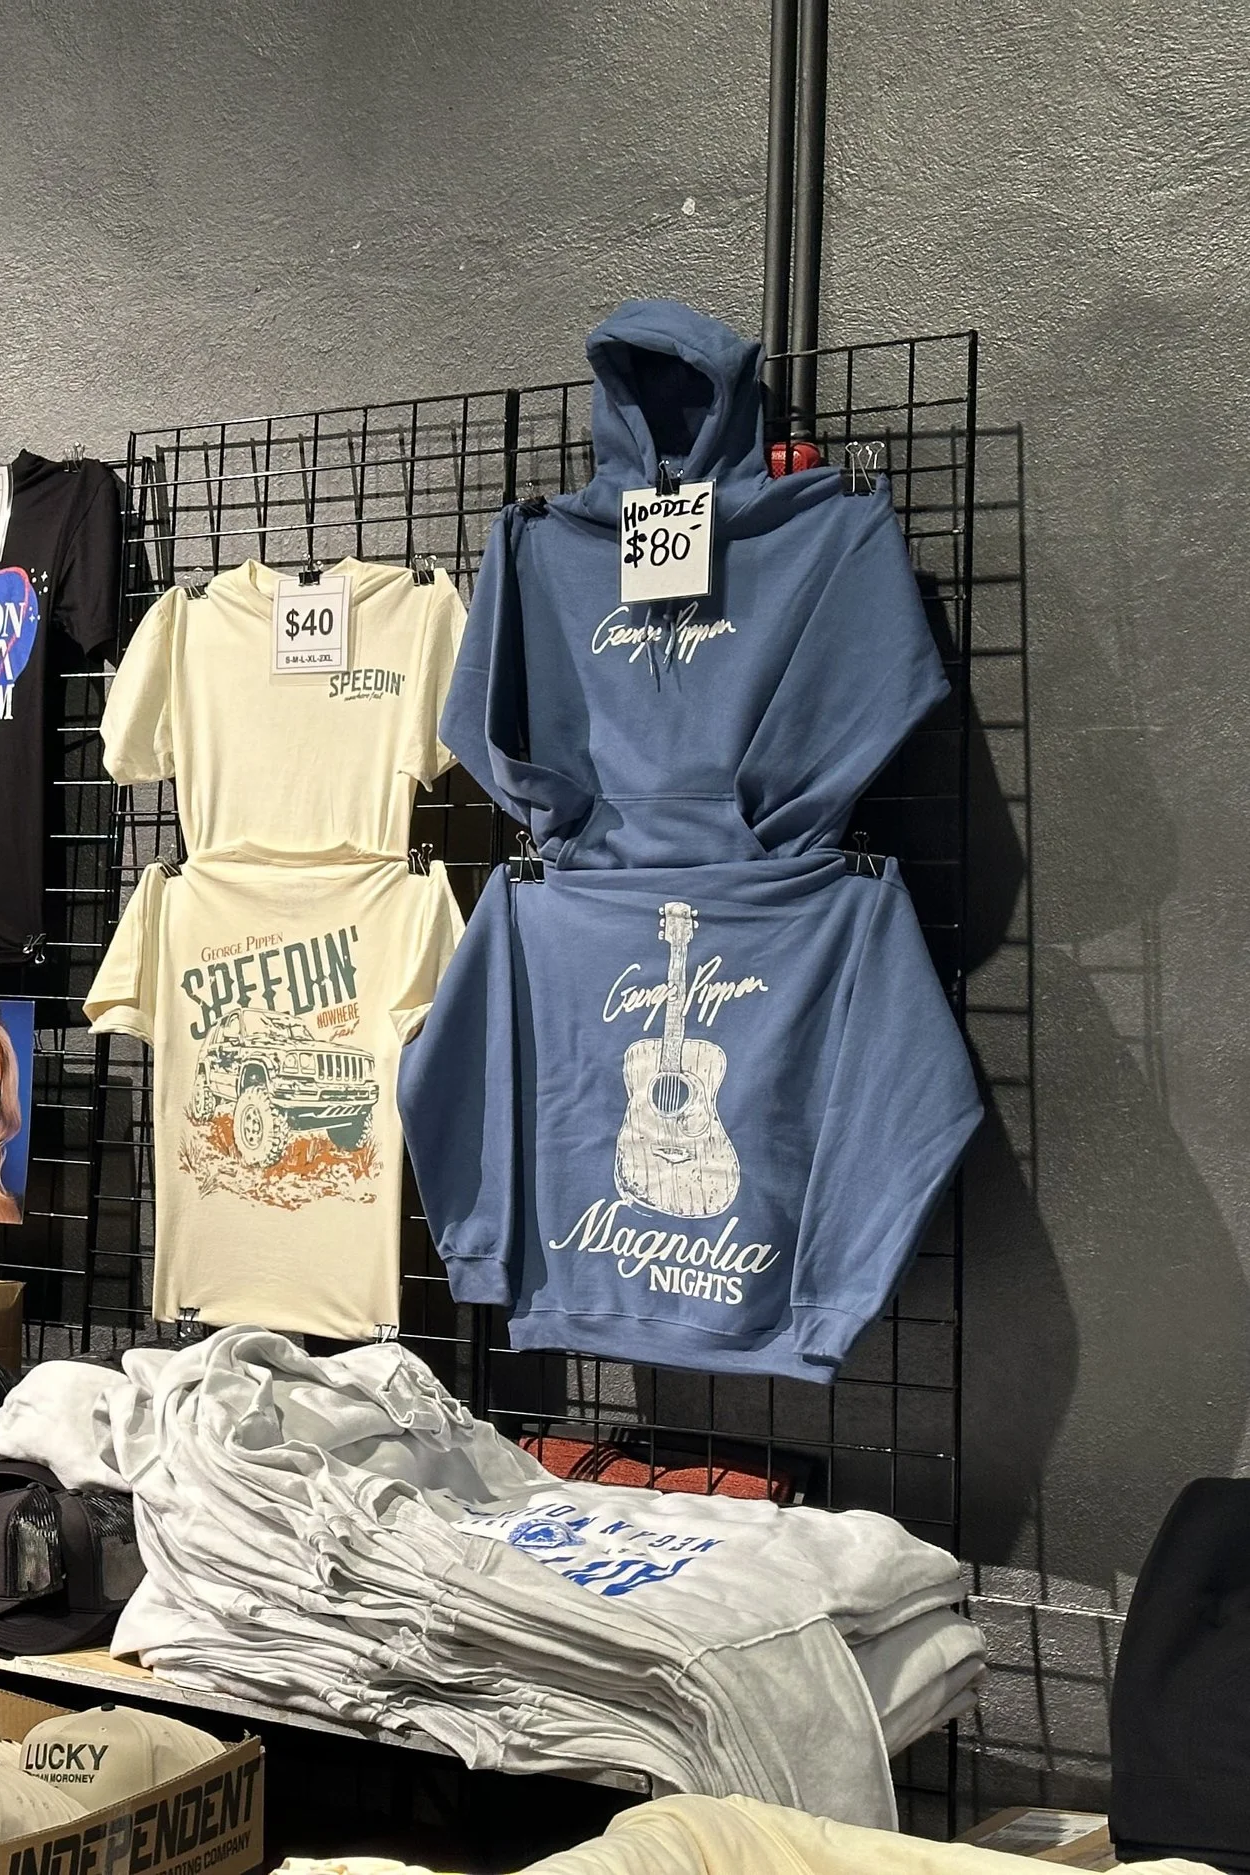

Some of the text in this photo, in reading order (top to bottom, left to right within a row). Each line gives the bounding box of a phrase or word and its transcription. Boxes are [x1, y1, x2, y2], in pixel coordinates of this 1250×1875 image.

[623, 491, 710, 532] HOODIE
[285, 607, 334, 641] $40
[591, 605, 662, 664] George
[285, 654, 333, 664] S-M-L-XL-2XL
[329, 669, 405, 698] SPEEDIN'
[200, 931, 284, 963] GEORGE PIPPEN
[180, 924, 359, 1041] SPEEDIN'
[316, 1002, 360, 1030] NOWHERE
[549, 1197, 781, 1279] Magnolia
[649, 1264, 744, 1305] NIGHTS
[26, 1743, 109, 1771] LUCKY
[49, 1773, 95, 1784] MORONEY
[155, 1830, 251, 1875] ADING COMPANY
